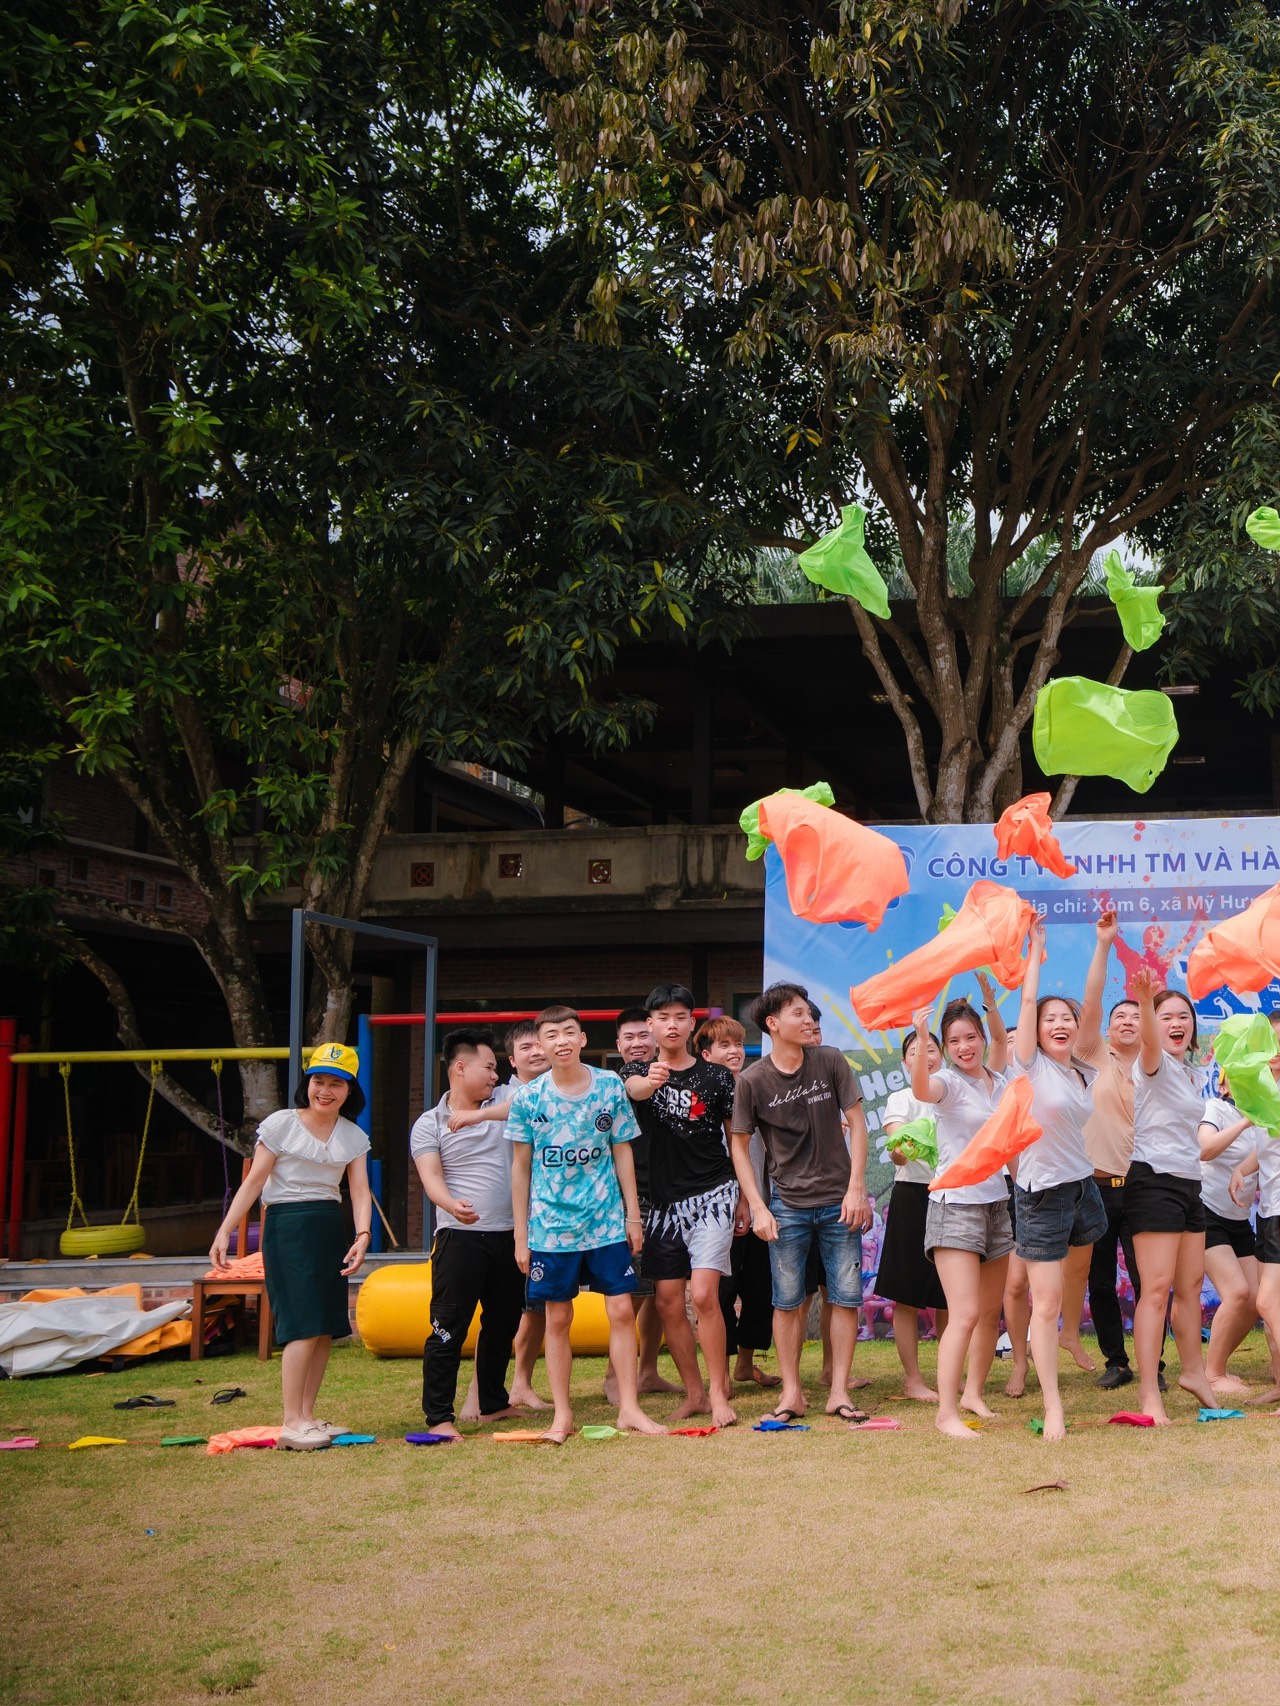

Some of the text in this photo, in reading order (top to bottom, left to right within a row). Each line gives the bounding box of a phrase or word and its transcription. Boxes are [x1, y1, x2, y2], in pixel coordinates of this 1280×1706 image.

[927, 852, 1008, 878] CÔNG
[1064, 854, 1136, 875] NHH
[1144, 853, 1186, 873] TM
[1194, 845, 1233, 872] VÀ
[1053, 897, 1087, 914] chỉ:
[1091, 896, 1134, 913] Xóm
[1138, 899, 1155, 914] 6,
[1160, 896, 1182, 911] xã
[1187, 895, 1215, 913] Mỹ
[1220, 894, 1254, 910] Hư
